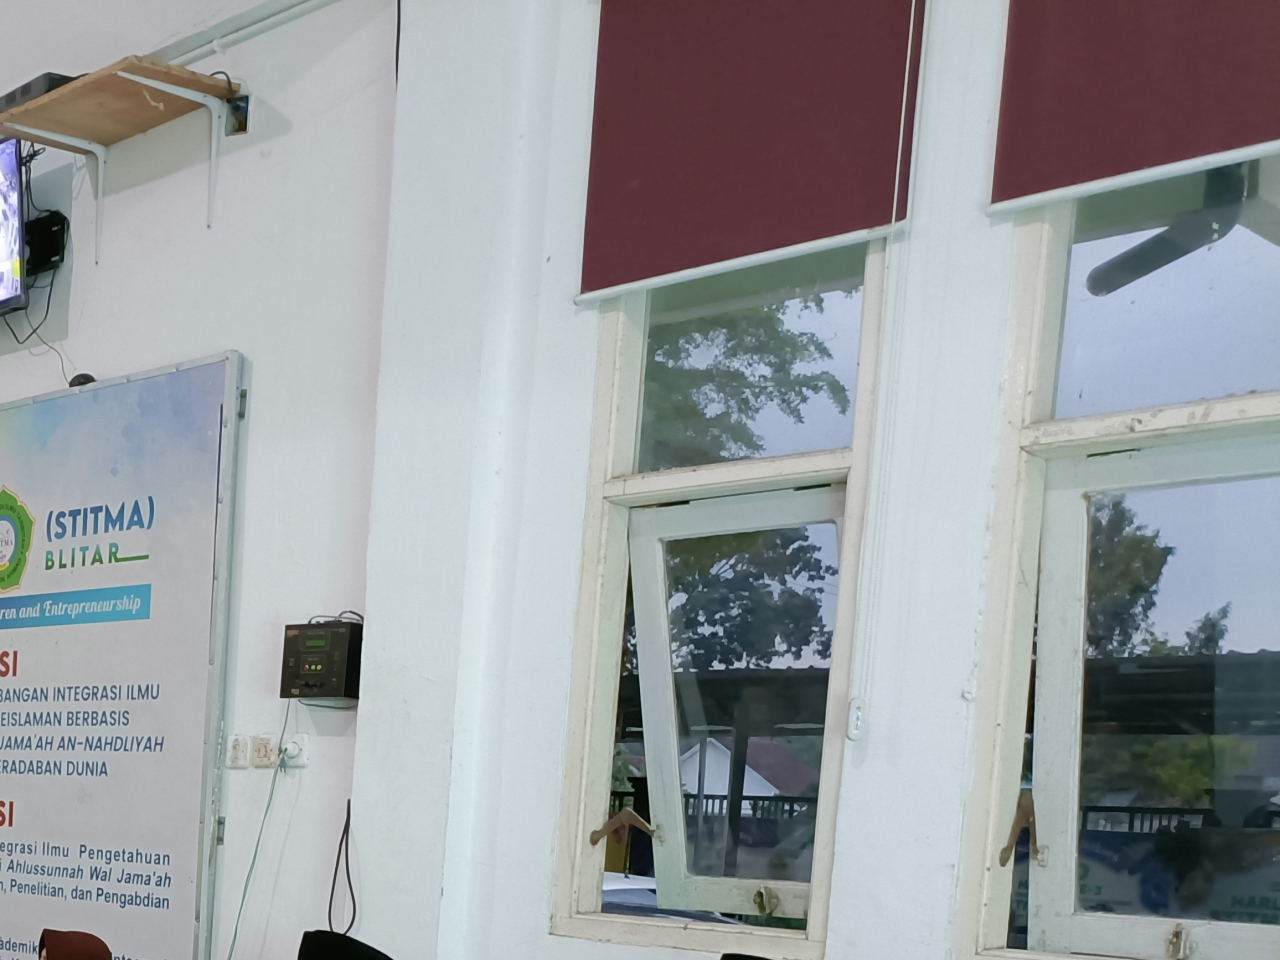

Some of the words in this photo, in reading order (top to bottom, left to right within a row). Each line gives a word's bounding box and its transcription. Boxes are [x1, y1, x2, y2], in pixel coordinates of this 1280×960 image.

[46, 496, 155, 542] (STITMA)
[45, 542, 149, 571] BLITAR
[19, 603, 40, 619] and
[43, 594, 141, 619] Entrepreneurship
[52, 685, 121, 702] INTEGRASI
[126, 683, 160, 700] ILMU
[66, 710, 130, 726] BERBASIS
[57, 736, 165, 752] AN-NAHDLIYAH
[66, 760, 108, 777] DUNIA
[42, 841, 69, 858] Ilmu
[79, 844, 171, 866] Pengetahuan
[6, 858, 84, 879] Ahlussunnah
[89, 866, 112, 882] Wal
[116, 868, 172, 888] Jama'ah
[10, 878, 67, 901] Penelitian,
[70, 885, 92, 901] dan
[96, 887, 170, 910] Pengabdian
